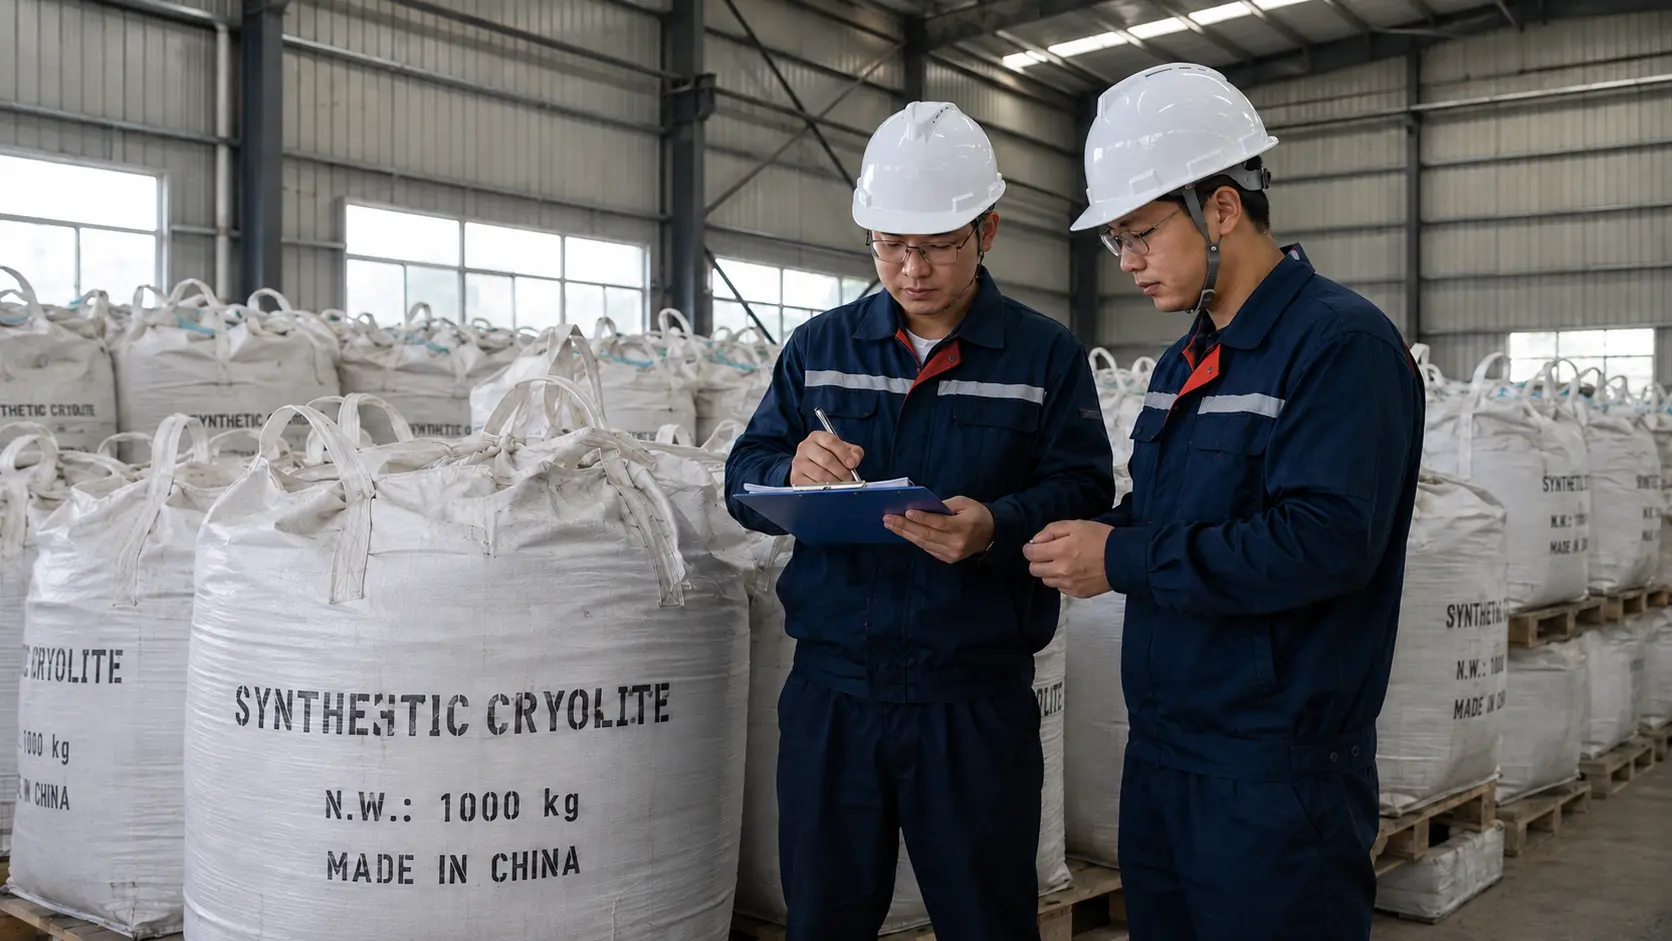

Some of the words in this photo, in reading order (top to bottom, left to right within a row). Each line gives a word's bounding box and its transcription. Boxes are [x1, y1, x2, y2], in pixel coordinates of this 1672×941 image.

[0, 403, 46, 417] THETIC
[31, 646, 123, 684] CRYOLITE
[486, 682, 670, 736] CRYOLITE
[1453, 696, 1484, 720] MADE
[52, 733, 70, 765] kg
[34, 781, 70, 811] CHINA
[325, 789, 412, 822] N.W.:
[440, 790, 521, 823] 1000
[543, 787, 580, 823] kg
[327, 850, 415, 885] MADE
[438, 854, 468, 885] IN
[491, 845, 581, 883] CHINA
